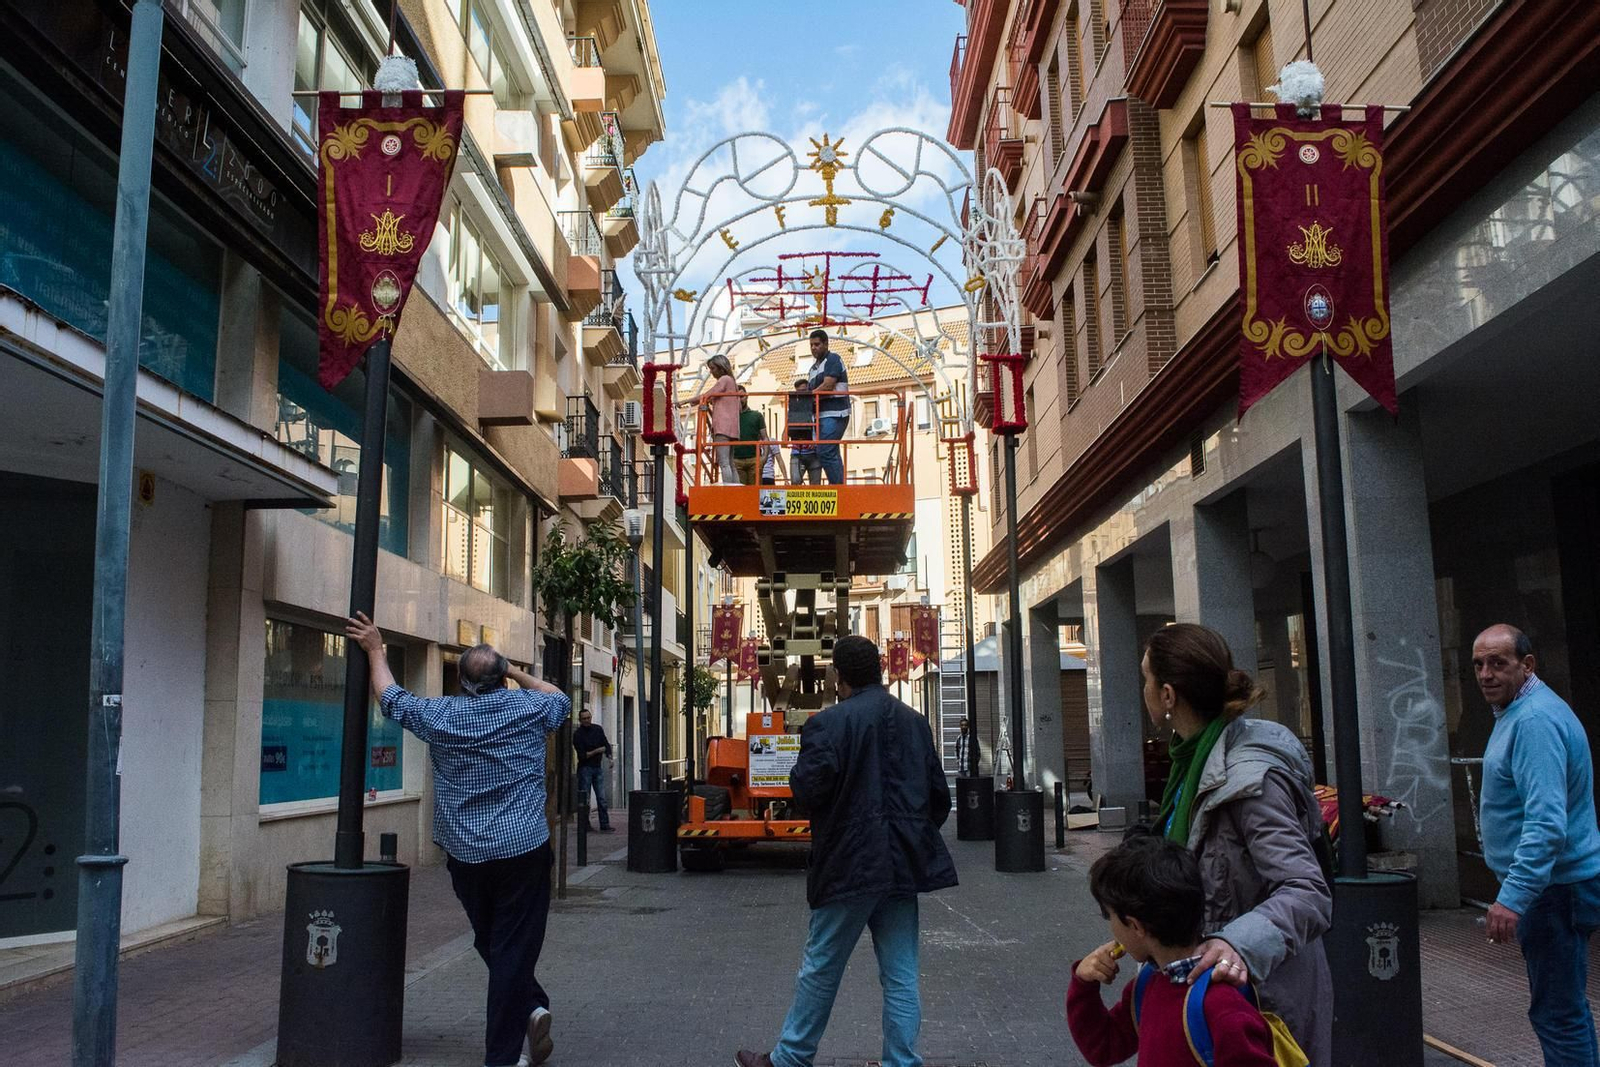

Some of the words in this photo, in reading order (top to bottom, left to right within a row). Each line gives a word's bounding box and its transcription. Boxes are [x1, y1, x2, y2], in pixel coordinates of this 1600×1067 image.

[108, 30, 192, 125] LER
[786, 500, 802, 514] 959
[803, 500, 819, 514] 300
[820, 500, 836, 514] 097
